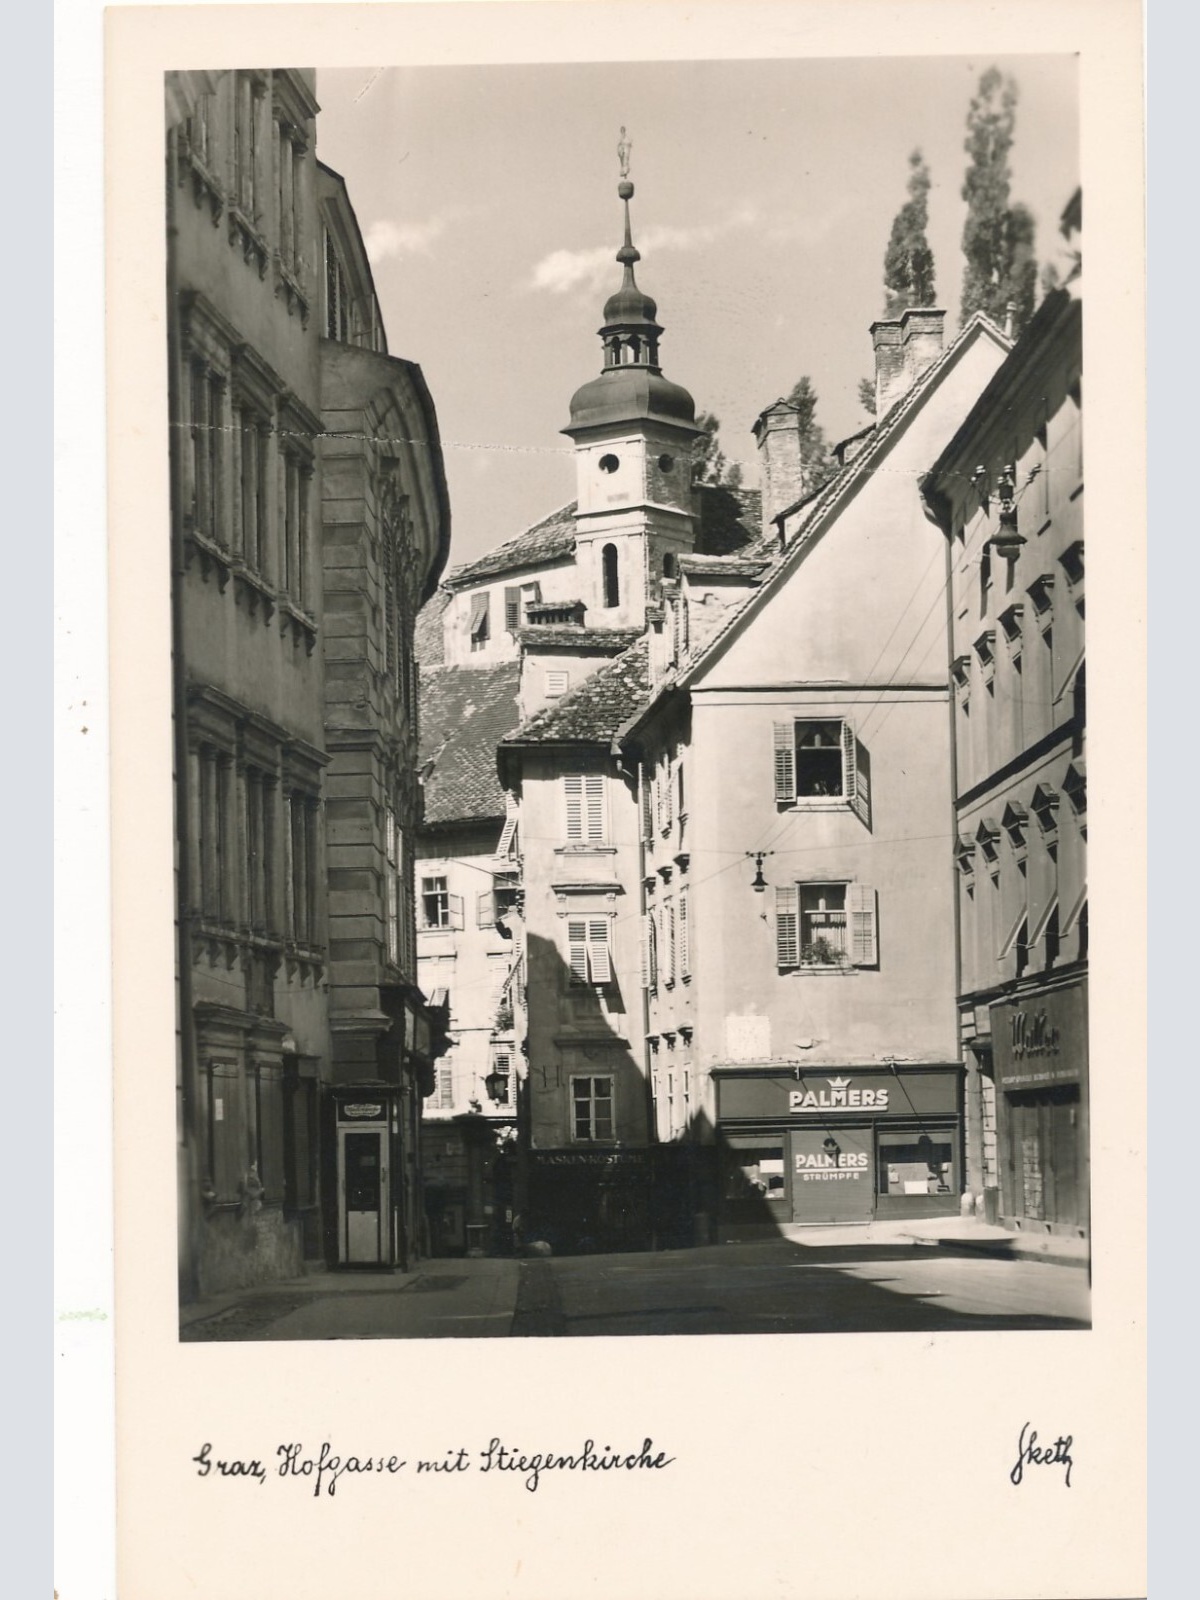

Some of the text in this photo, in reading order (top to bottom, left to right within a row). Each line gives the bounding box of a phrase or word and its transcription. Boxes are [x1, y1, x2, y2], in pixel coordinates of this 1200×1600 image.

[789, 1089, 888, 1107] PALMERS
[795, 1153, 868, 1168] PALMERS
[803, 1172, 859, 1181] STRÜMPFE
[193, 1437, 677, 1497] Graz, Hofgasse mit Stiegenkirche
